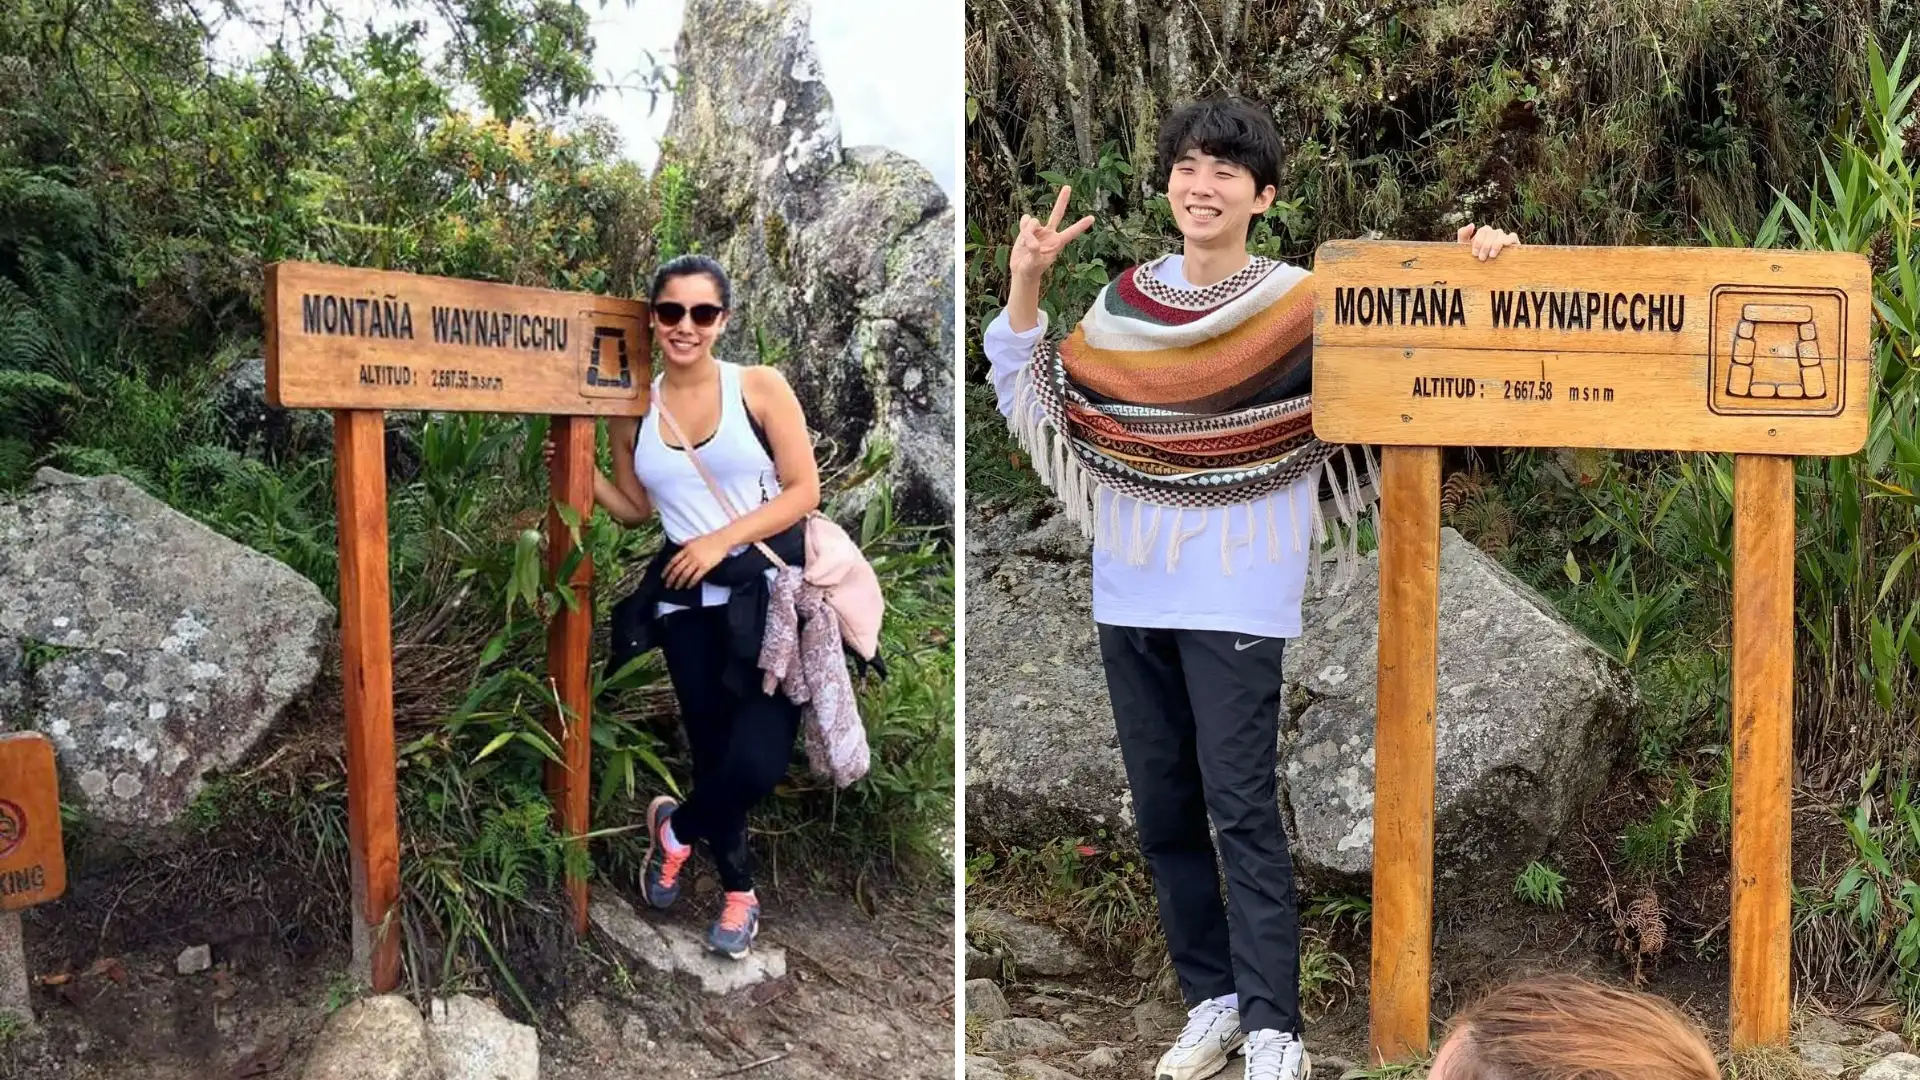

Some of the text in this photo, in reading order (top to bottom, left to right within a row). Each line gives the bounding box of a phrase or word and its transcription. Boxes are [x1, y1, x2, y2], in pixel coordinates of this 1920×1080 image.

[303, 293, 568, 351] MONTAÑA WAYNAPICCHU
[1335, 281, 1685, 332] MONTAÑA WAYNAPICCHU
